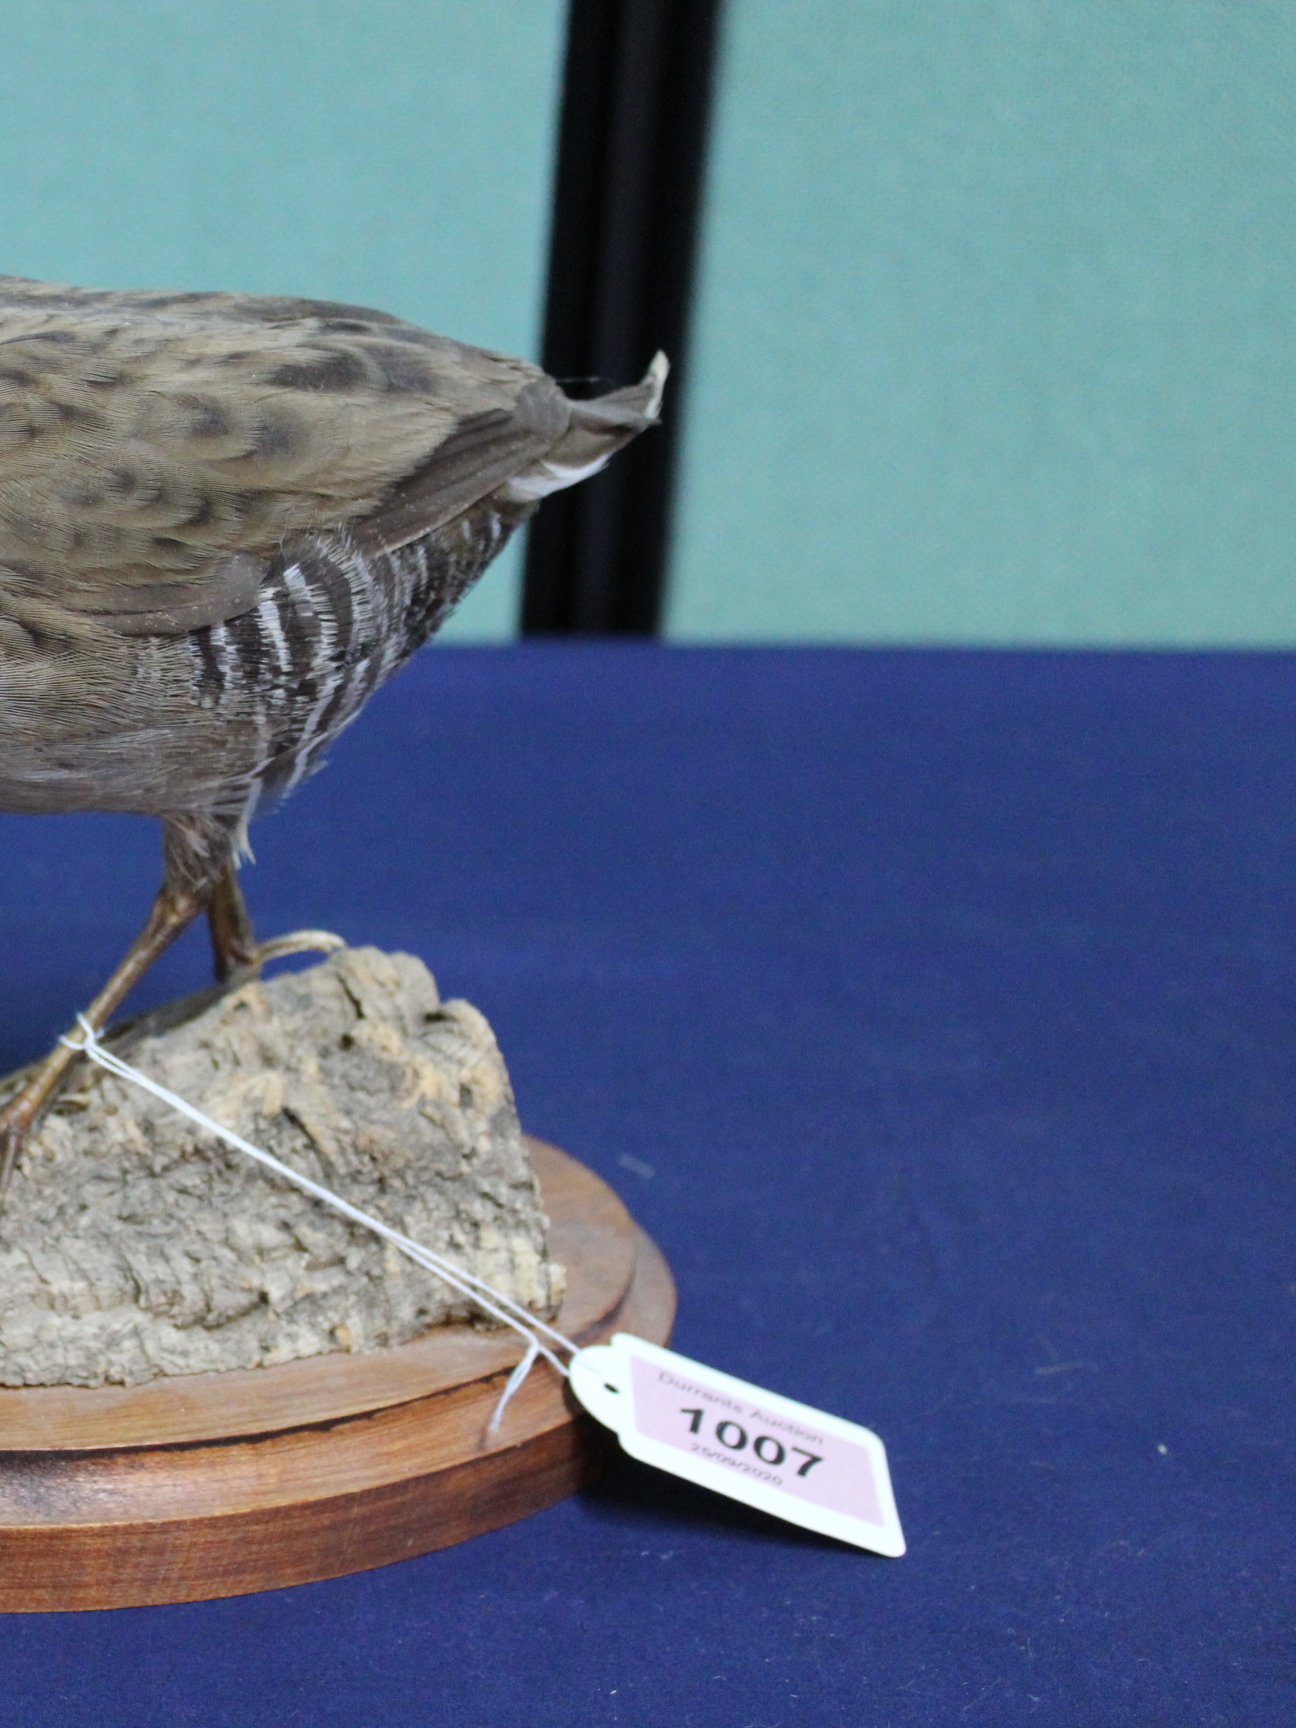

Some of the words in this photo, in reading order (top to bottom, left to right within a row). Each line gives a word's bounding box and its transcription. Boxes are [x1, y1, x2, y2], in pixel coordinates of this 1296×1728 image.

[658, 1371, 743, 1414] Durrants
[751, 1410, 824, 1445] Auction
[680, 1408, 824, 1478] 1007
[690, 1443, 783, 1486] 25/09/2020
